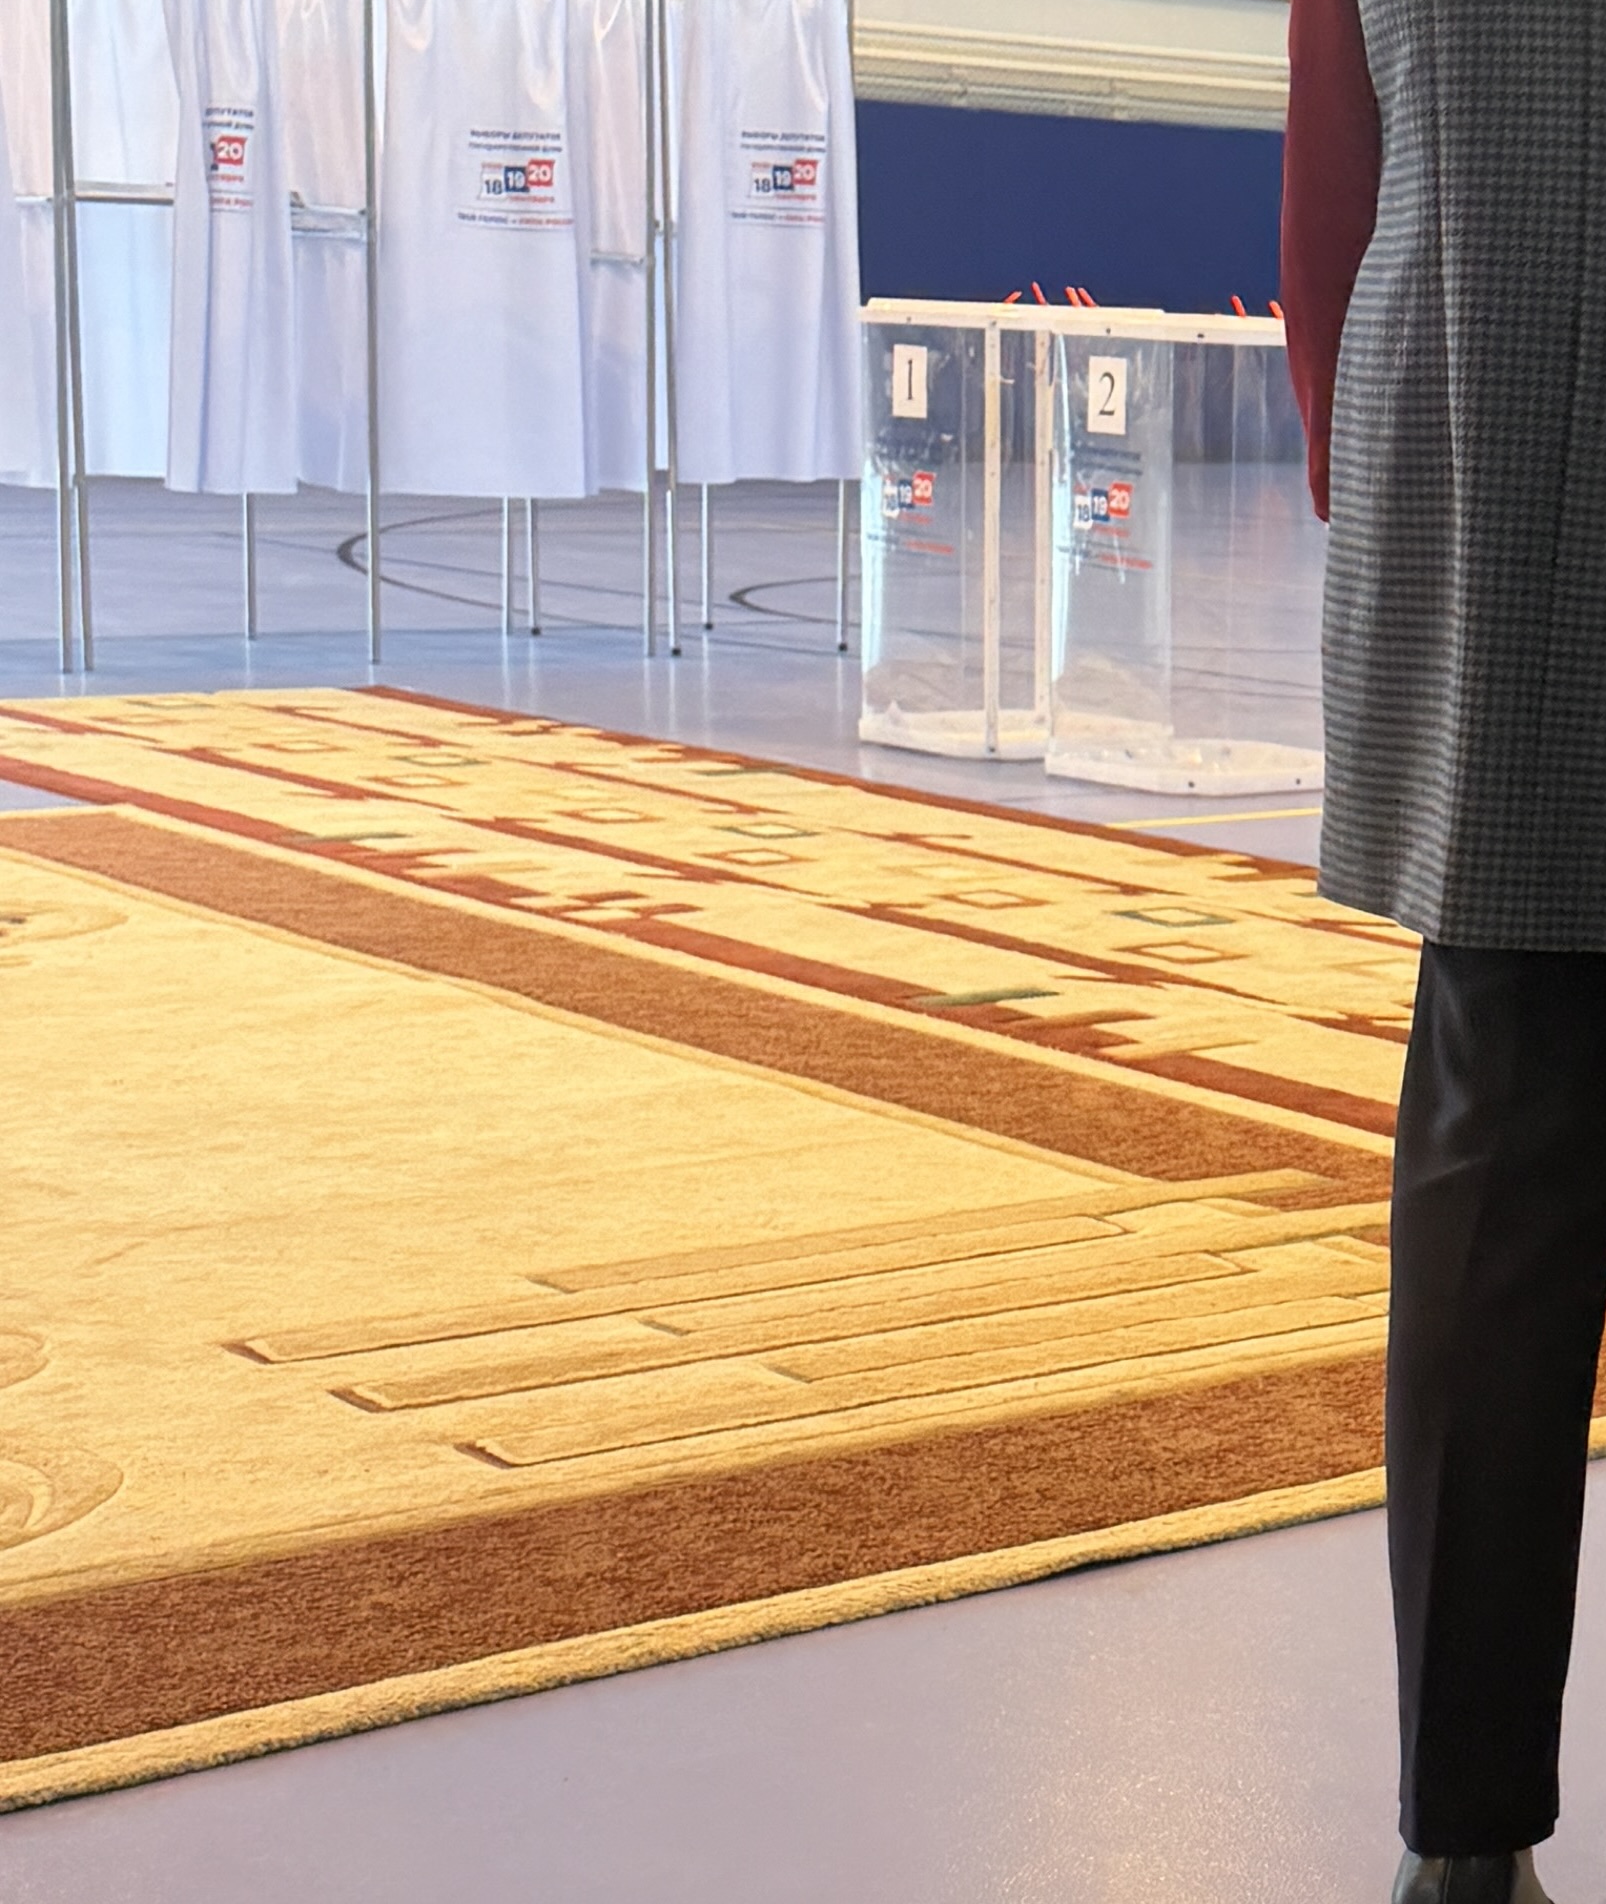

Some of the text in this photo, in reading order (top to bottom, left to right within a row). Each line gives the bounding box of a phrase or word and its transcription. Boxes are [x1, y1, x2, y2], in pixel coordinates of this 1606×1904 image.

[217, 141, 243, 160] 20
[484, 163, 553, 195] 18 19 20
[754, 164, 816, 193] 18 19 20
[907, 358, 914, 401] 1
[1098, 371, 1116, 416] 2
[913, 478, 933, 499] 20
[1093, 495, 1108, 515] 19
[1109, 489, 1130, 511] 20
